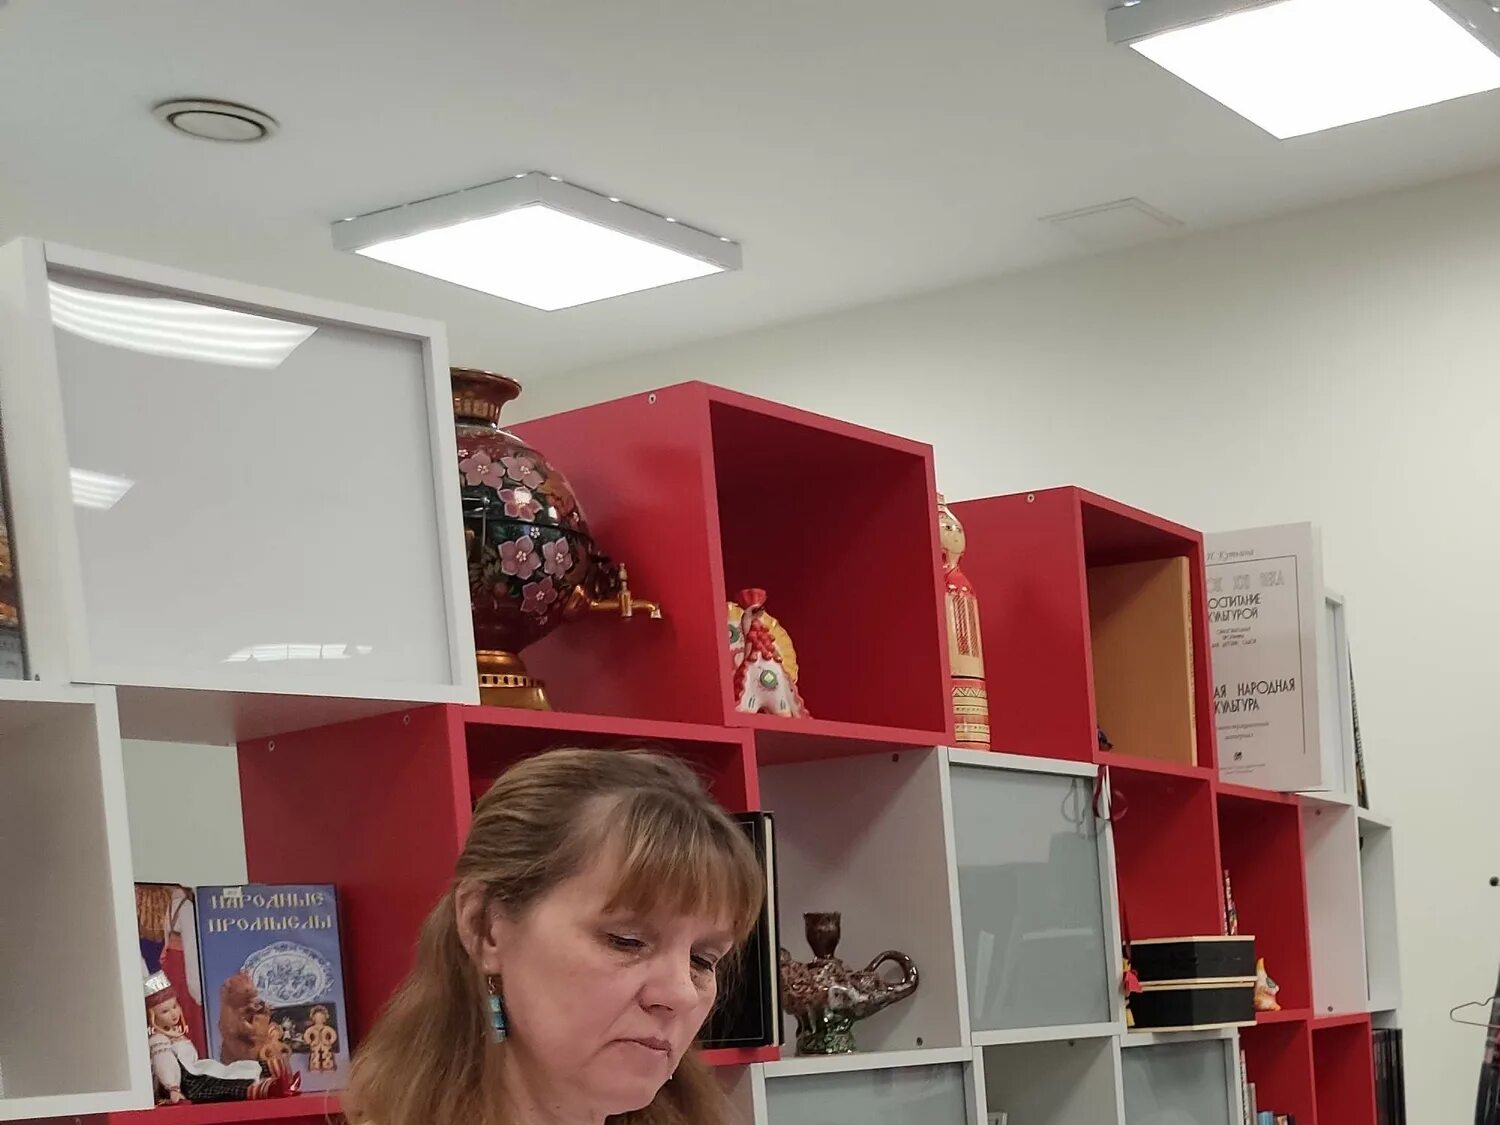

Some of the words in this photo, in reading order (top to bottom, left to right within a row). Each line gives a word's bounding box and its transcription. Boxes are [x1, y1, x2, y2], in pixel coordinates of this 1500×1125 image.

[1208, 593, 1262, 612] ОСПИТАНИЕ
[1213, 684, 1227, 699] АЯ
[1237, 677, 1296, 696] НАРОДНАЯ
[1213, 697, 1260, 714] КУЛЬТУРА
[209, 890, 327, 910] НАРОДНЫЕ
[207, 914, 332, 934] ПРОМЫСЛЫ
